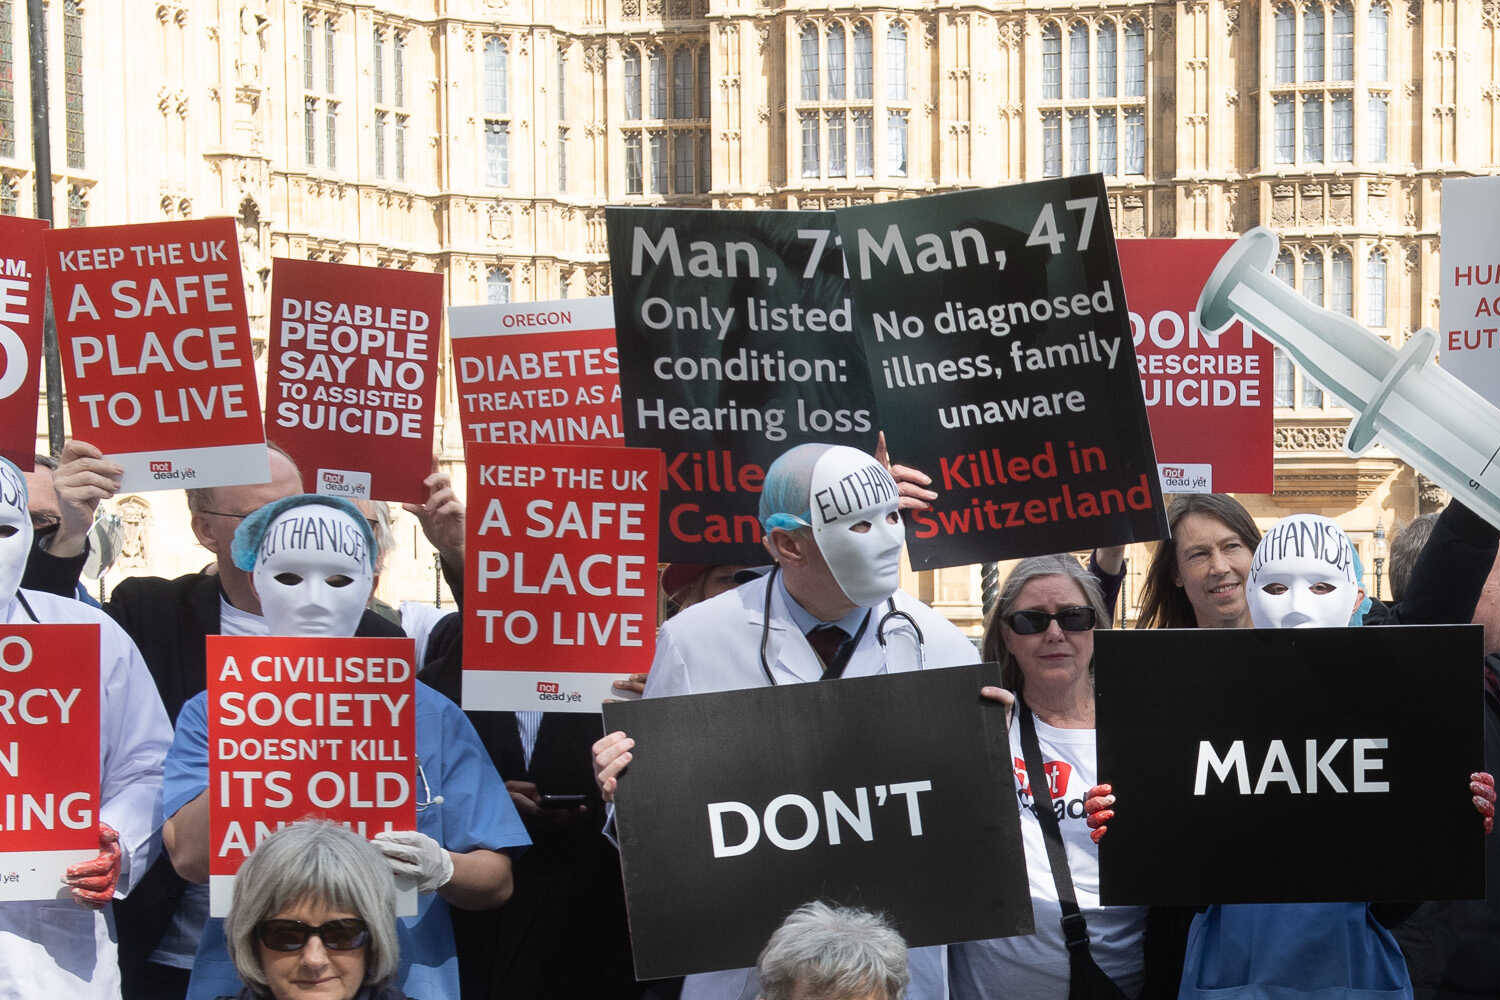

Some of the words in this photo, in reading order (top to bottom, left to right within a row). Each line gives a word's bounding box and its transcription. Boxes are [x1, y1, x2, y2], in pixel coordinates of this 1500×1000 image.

[60, 247, 125, 272] KEEP
[130, 243, 184, 267] THE
[190, 240, 227, 262] UK
[631, 225, 778, 286] Man,
[857, 224, 1009, 281] Man,
[1025, 196, 1098, 256] 47
[67, 283, 100, 322] A
[111, 274, 233, 319] SAFE
[282, 298, 429, 331] DISABLED
[873, 312, 925, 343] No
[934, 281, 1115, 338] diagnosed
[503, 312, 572, 328] OREGON
[641, 296, 734, 341] Only
[748, 298, 853, 333] listed
[71, 326, 242, 378] PLACE
[280, 322, 428, 360] PEOPLE
[881, 353, 1001, 390] illness,
[1009, 331, 1122, 373] family
[279, 351, 357, 384] SAY
[368, 358, 424, 391] NO
[460, 347, 619, 383] DIABETES
[653, 348, 846, 382] condition:
[79, 392, 142, 428] TO
[155, 384, 248, 423] LIVE
[279, 382, 307, 400] TO
[313, 386, 423, 410] ASSISTED
[463, 389, 569, 413] TREATED
[575, 386, 605, 404] AS
[938, 390, 1086, 430] unaware
[276, 402, 422, 439] SUICIDE
[637, 398, 785, 442] Hearing
[799, 400, 872, 432] loss
[152, 463, 169, 471] not
[154, 470, 178, 480] dead
[180, 469, 196, 480] yet
[479, 464, 545, 488] KEEP
[552, 468, 604, 489] THE
[612, 470, 648, 491] UK
[939, 442, 1055, 491] Killed
[1066, 439, 1106, 473] in
[478, 499, 511, 537] A
[526, 500, 646, 541] SAFE
[911, 475, 1153, 541] Switzerland
[477, 551, 646, 597] PLACE
[476, 609, 538, 645] TO
[553, 611, 643, 647] LIVE
[218, 656, 242, 681] A
[250, 657, 410, 683] CIVILISED
[218, 693, 410, 727] SOCIETY
[218, 739, 342, 760] DOESN'T
[350, 738, 408, 761] KILL
[1194, 738, 1390, 796] MAKE
[219, 772, 292, 808] ITS
[307, 772, 410, 809] OLD
[707, 780, 933, 859] DON'T
